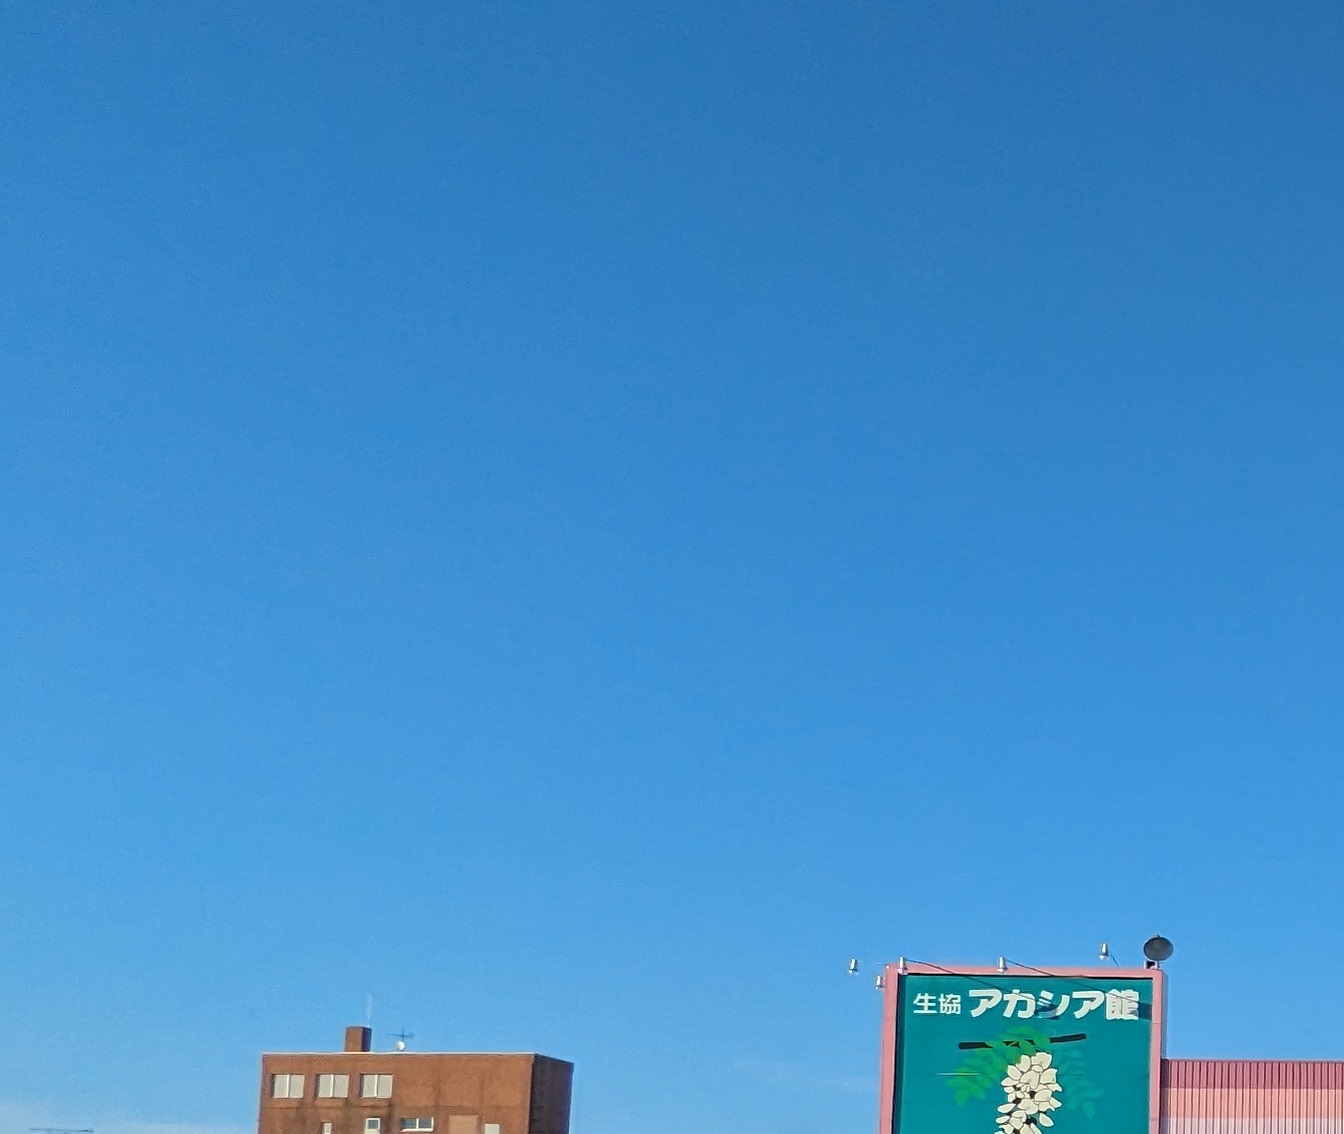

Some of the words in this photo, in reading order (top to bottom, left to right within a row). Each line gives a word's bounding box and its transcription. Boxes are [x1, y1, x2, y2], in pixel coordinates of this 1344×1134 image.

[913, 993, 961, 1014] 生協
[968, 988, 1139, 1020] アカシア館
